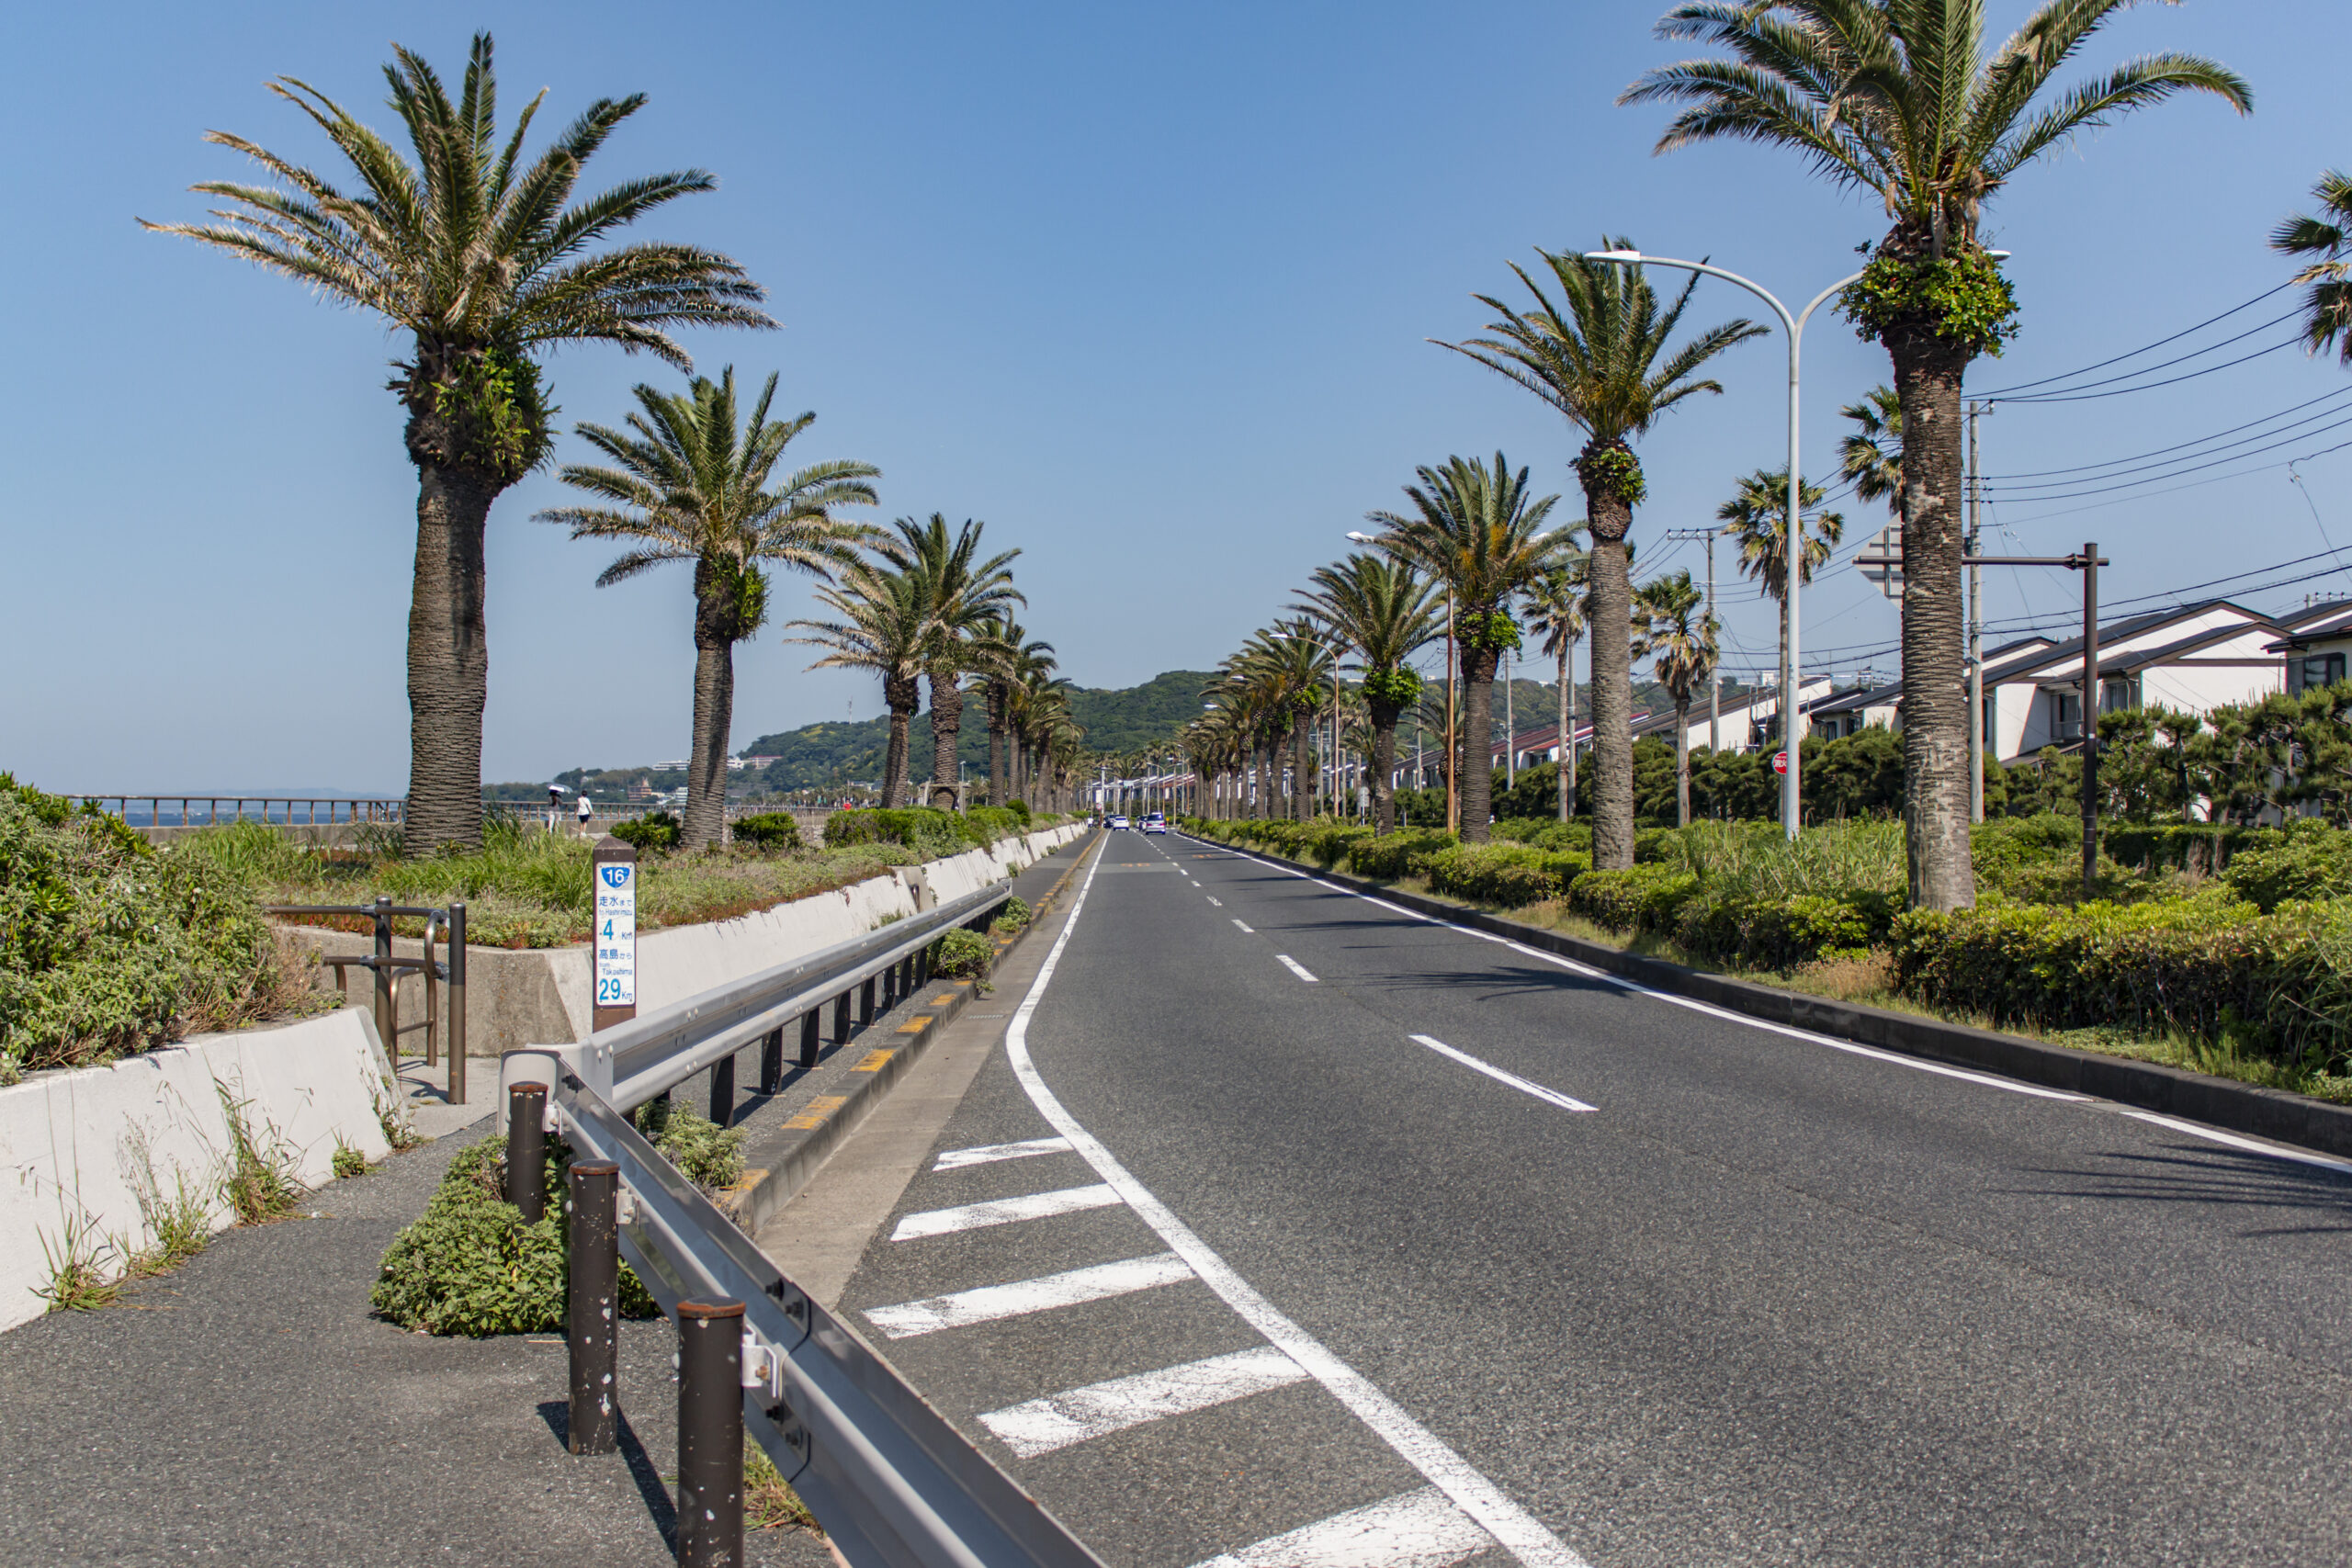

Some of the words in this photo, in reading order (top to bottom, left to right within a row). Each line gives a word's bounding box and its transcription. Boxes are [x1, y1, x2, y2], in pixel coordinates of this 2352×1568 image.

[1774, 760, 1787, 768] 消火
[606, 869, 625, 884] 16
[599, 896, 632, 907] 走水まで
[603, 919, 614, 941] 4
[599, 949, 632, 959] 高島から
[599, 978, 621, 1000] 29
[622, 991, 632, 999] Km
